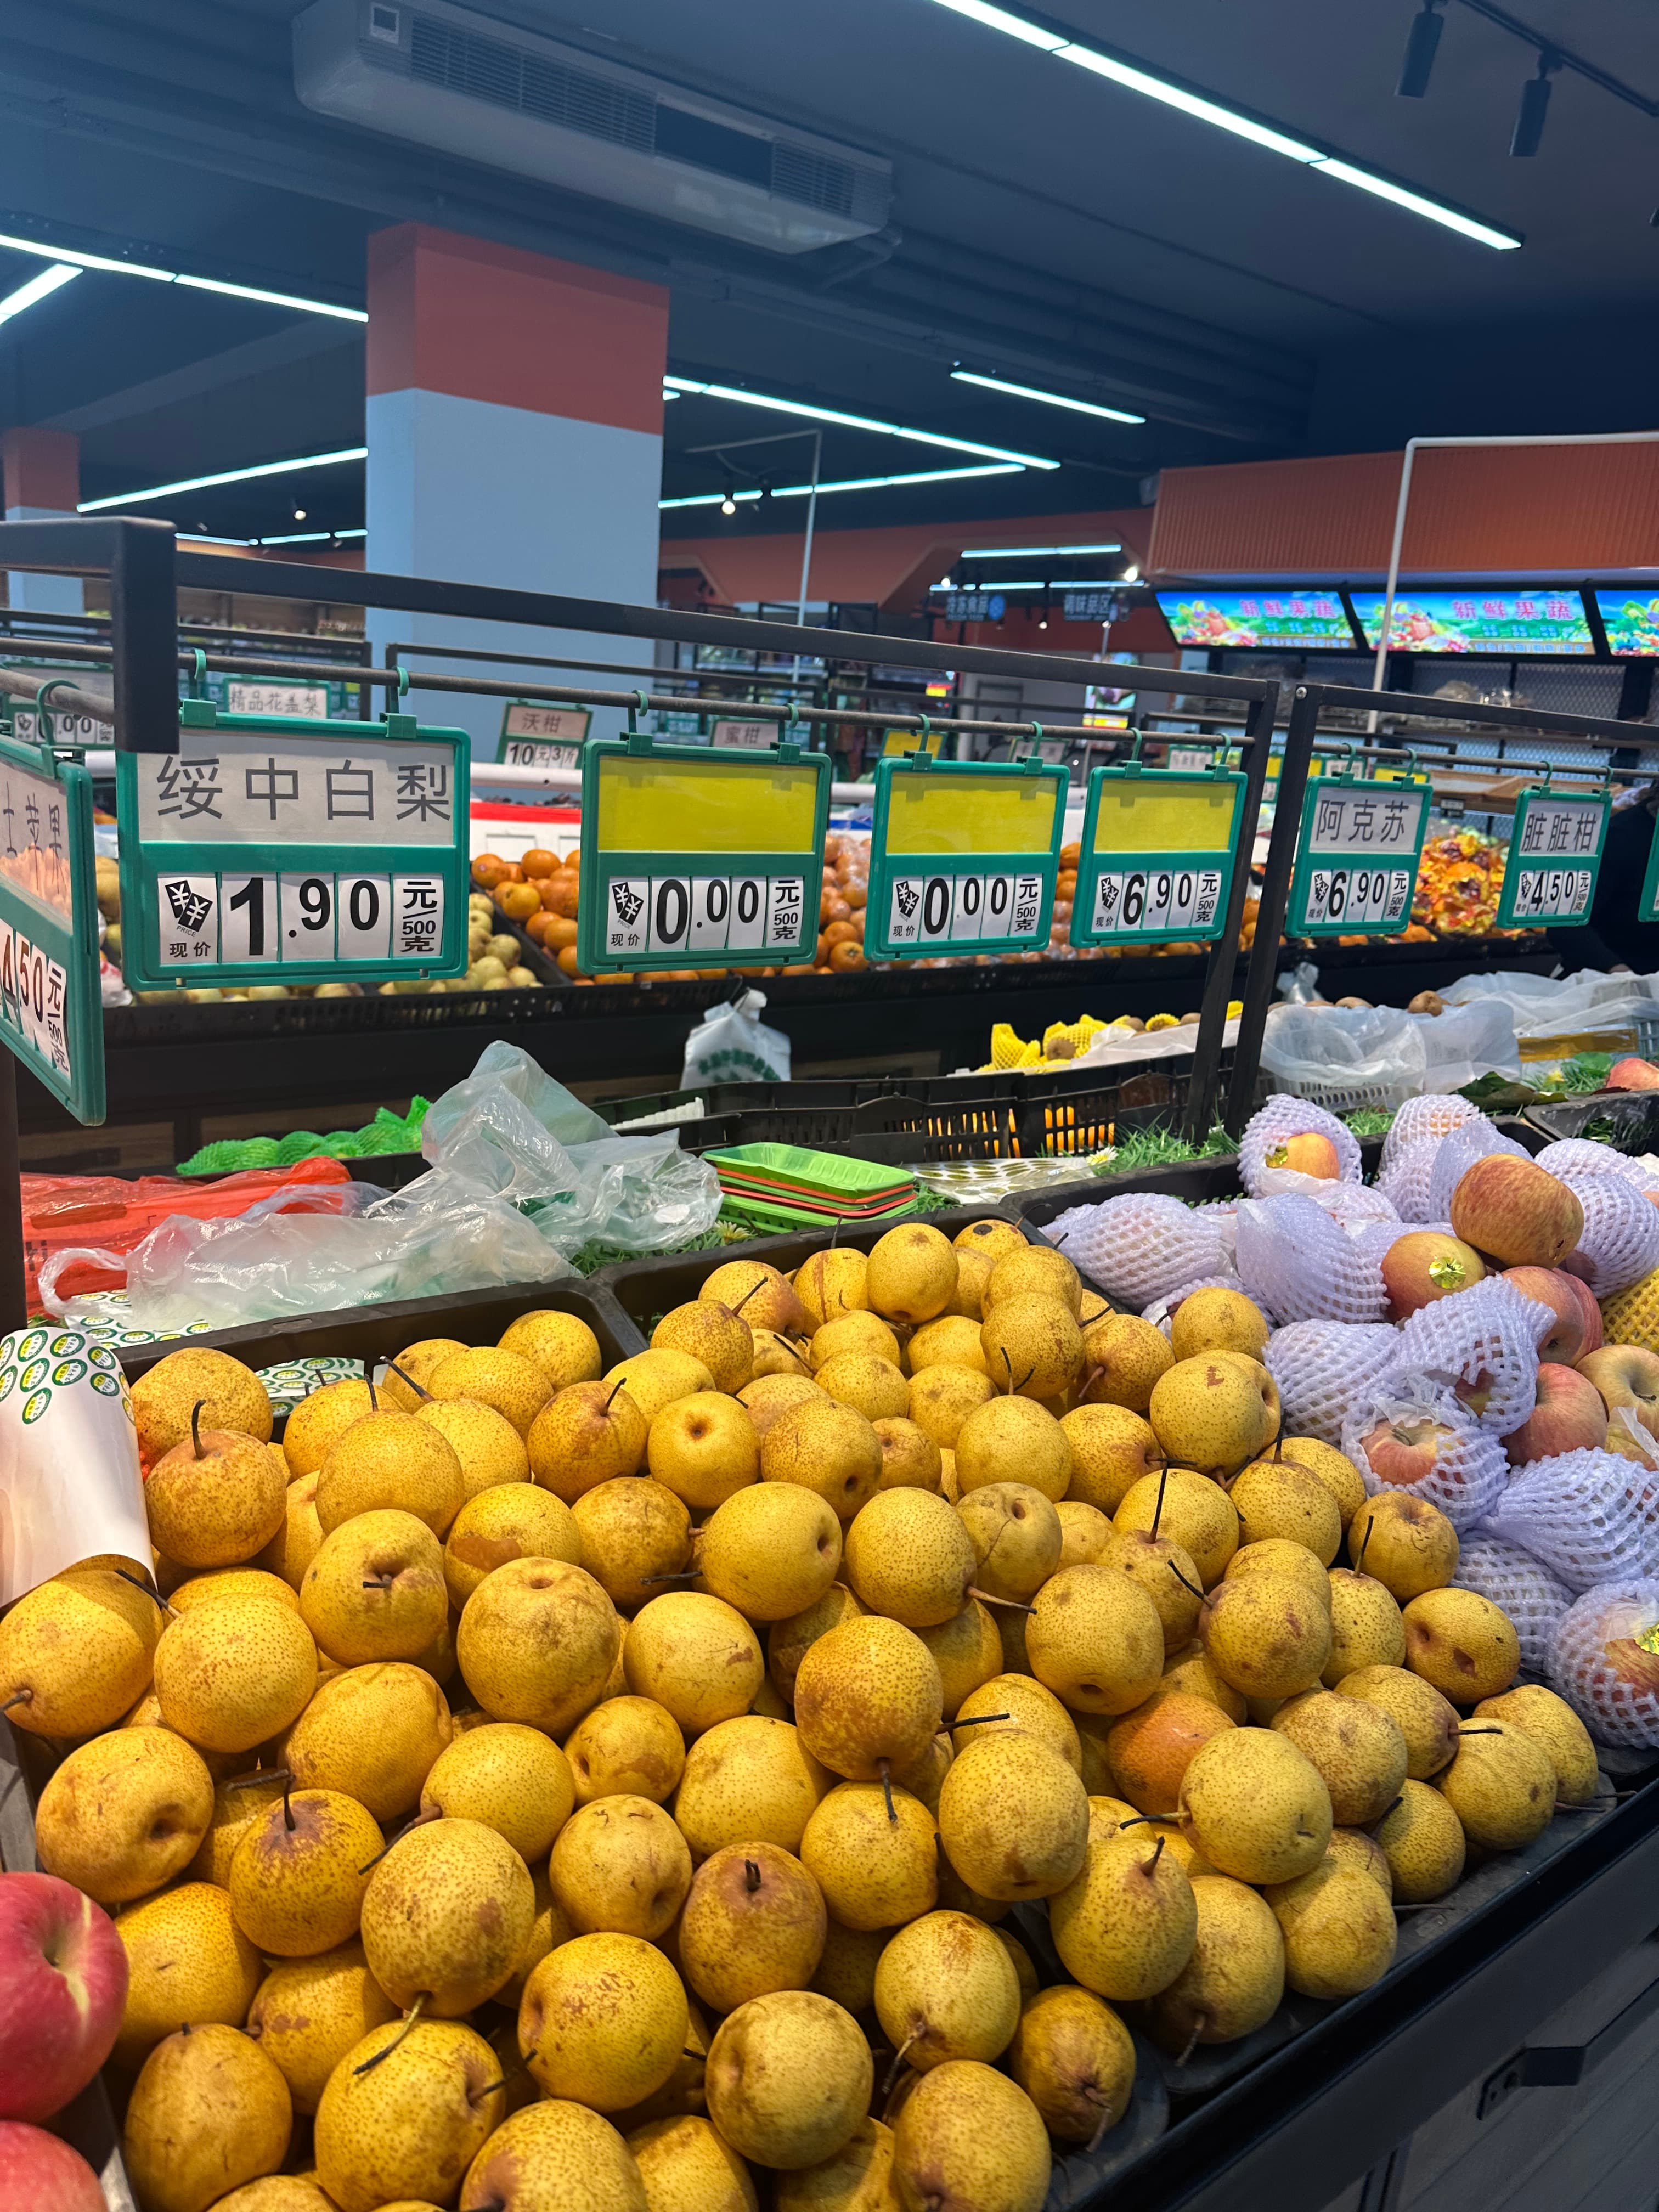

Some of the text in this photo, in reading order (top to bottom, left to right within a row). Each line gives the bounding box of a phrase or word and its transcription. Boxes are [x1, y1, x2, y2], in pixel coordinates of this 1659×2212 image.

[1452, 599, 1576, 621] 新鲜果蔬
[230, 686, 320, 715] 精品花盖梨
[522, 713, 562, 733] 沃柑
[725, 725, 760, 744] 蜜柑
[157, 755, 451, 822] 绥中白梨
[1316, 799, 1410, 844] 阿克苏
[1521, 812, 1596, 853] 脏脏柑
[1123, 874, 1192, 926] 6.90
[1329, 871, 1385, 917] 6.90
[1531, 872, 1573, 911] 4.50
[231, 877, 379, 956] 1.90
[617, 919, 631, 930] PRICE
[656, 879, 759, 944] 0.00
[1096, 916, 1114, 927] 现价
[176, 925, 196, 938] PRICE
[611, 934, 640, 946] 现价
[893, 925, 915, 937] 现价
[170, 941, 211, 958] 现价
[2, 934, 43, 1023] 4.50
